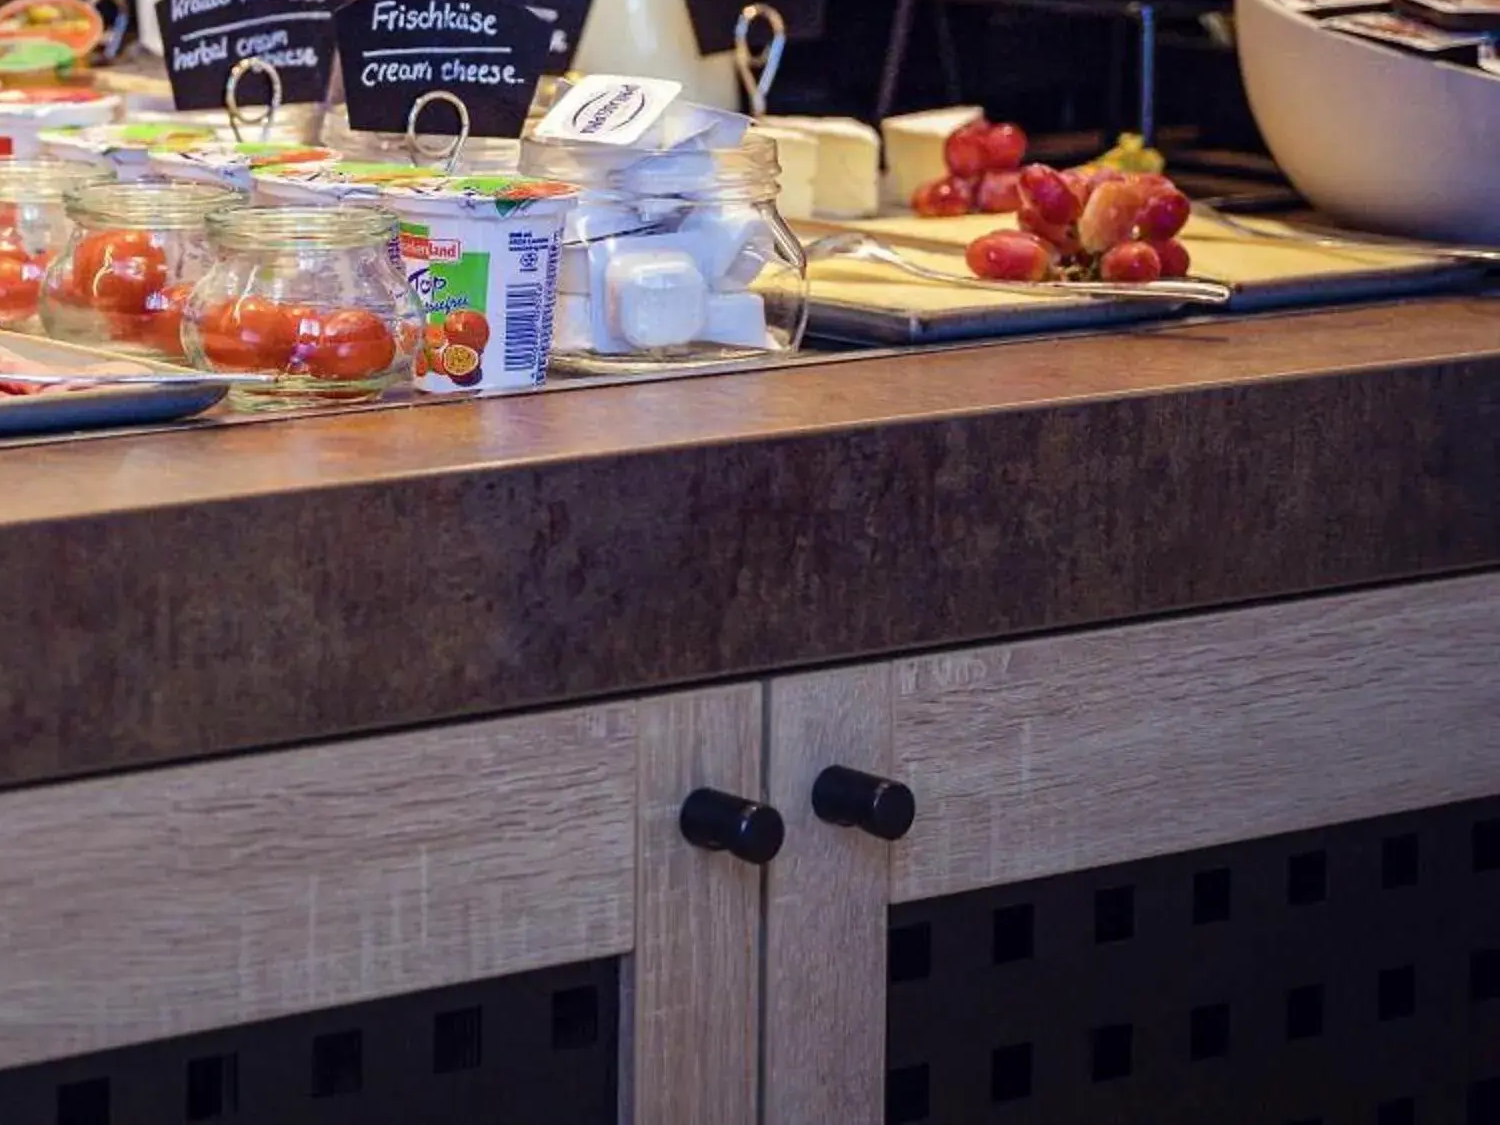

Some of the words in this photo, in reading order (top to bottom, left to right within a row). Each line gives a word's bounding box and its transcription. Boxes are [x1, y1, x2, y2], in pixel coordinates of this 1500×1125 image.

[371, 0, 498, 36] Frischkäse
[362, 61, 431, 86] cream
[408, 267, 447, 300] Top
